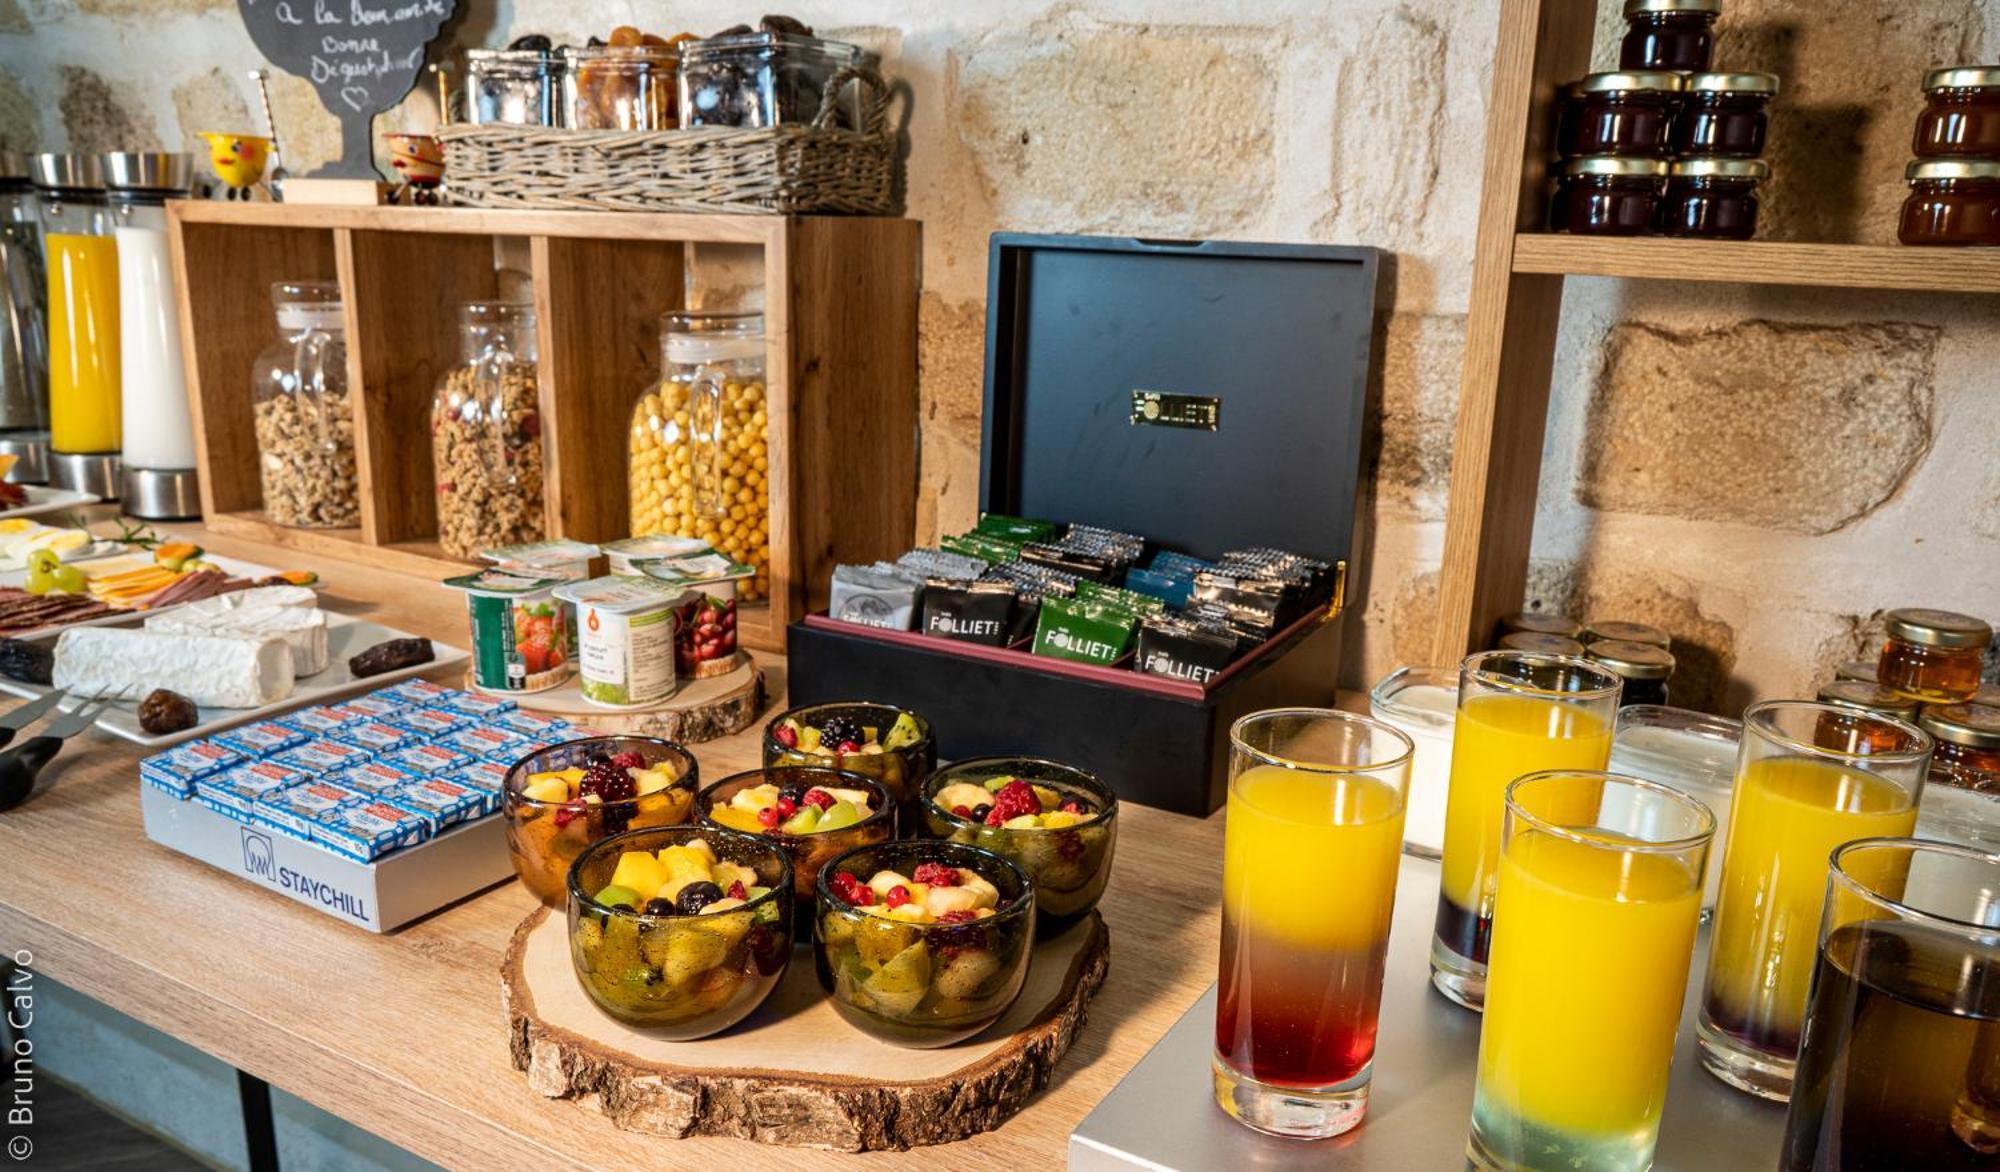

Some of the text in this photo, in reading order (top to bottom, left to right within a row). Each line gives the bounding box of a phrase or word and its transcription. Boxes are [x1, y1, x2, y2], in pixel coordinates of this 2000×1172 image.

[314, 0, 343, 25] la
[320, 35, 382, 54] Bonne
[930, 615, 994, 635] FOLLIET
[1044, 629, 1112, 660] FOLLIET
[1144, 654, 1215, 684] FOLLIET
[279, 866, 370, 922] STAYCHILL
